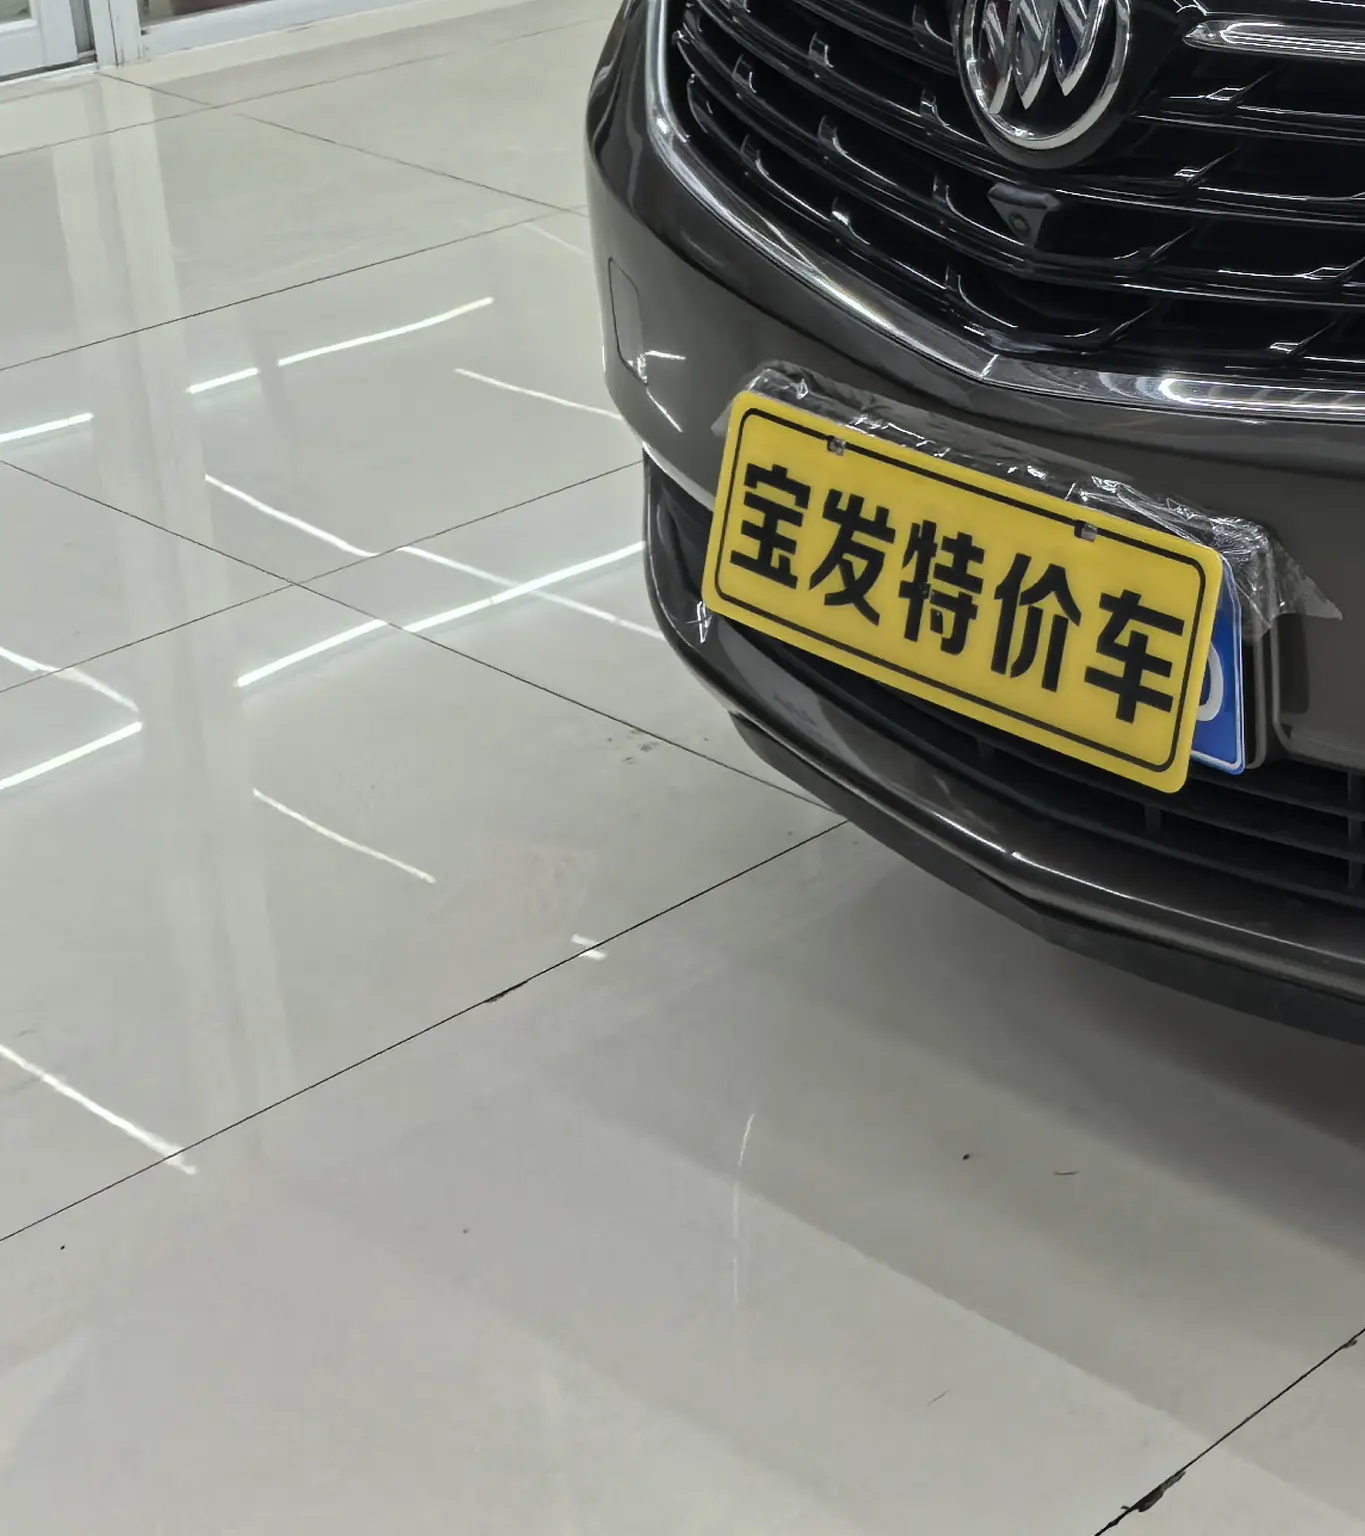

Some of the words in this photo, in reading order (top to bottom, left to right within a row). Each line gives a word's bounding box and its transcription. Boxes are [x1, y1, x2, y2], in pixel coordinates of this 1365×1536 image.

[729, 464, 1185, 724] 宝发特价车
